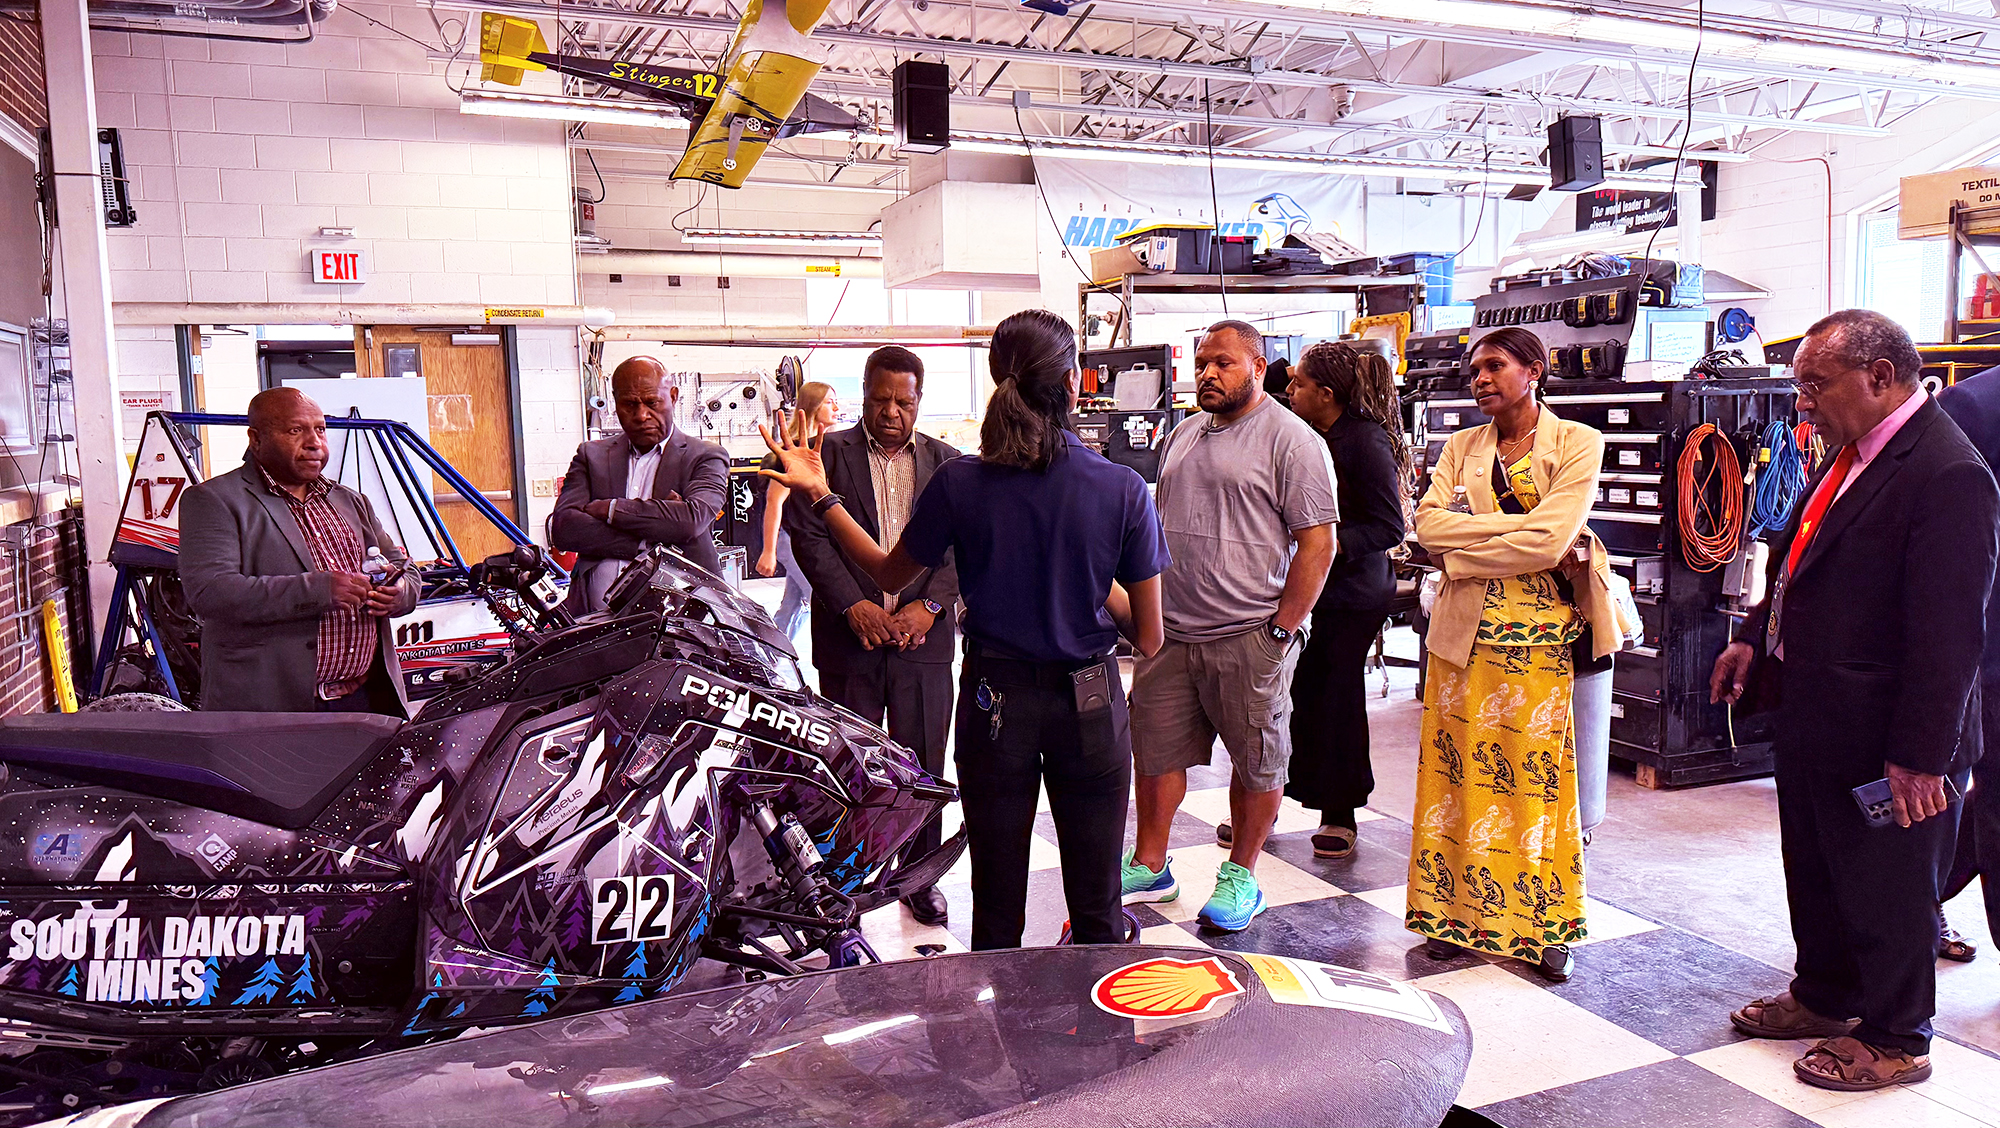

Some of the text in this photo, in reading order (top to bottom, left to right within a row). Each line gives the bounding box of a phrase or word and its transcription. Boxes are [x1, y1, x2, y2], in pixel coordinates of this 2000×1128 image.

[609, 62, 717, 98] Stinger 12
[1591, 206, 1604, 218] The
[1622, 198, 1642, 213] leader
[1643, 196, 1651, 210] in
[1979, 194, 1992, 202] DO
[321, 252, 359, 280] EXIT
[134, 476, 186, 520] 17
[398, 639, 486, 662] AKOTA MINES
[680, 674, 833, 747] POLARIS
[213, 849, 238, 872] CAMP
[596, 877, 670, 942] 22
[8, 914, 305, 962] SOUTH DAKOTA
[86, 958, 206, 1002] MINES
